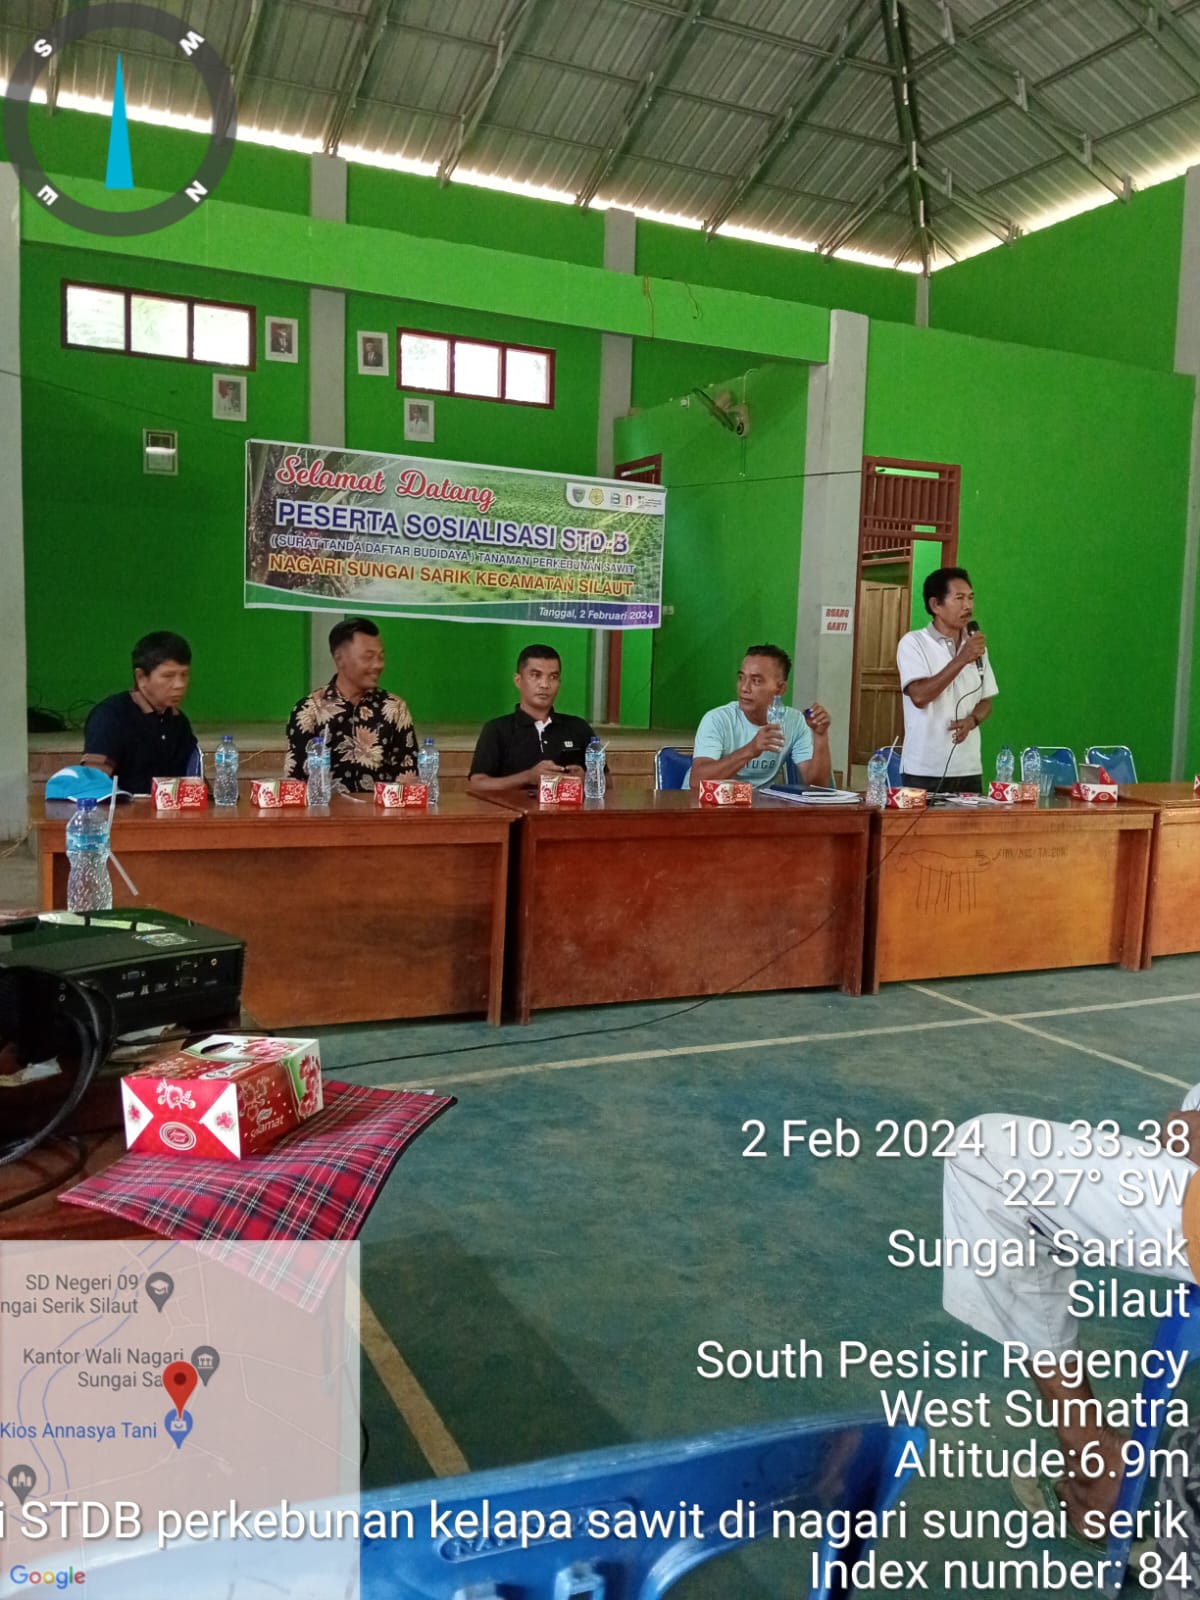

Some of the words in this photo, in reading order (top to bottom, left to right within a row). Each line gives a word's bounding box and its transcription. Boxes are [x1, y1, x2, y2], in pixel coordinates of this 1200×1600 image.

[275, 455, 385, 493] Selamat
[396, 468, 496, 514] Datang
[277, 500, 399, 535] PESERTA
[405, 512, 556, 549] SOSIALISASI
[561, 527, 629, 554] STD-B
[269, 553, 341, 575] NAGARI
[347, 561, 415, 581] SUNGAI
[420, 567, 472, 585] SARIK
[476, 571, 575, 593] KECAMATAN
[579, 580, 633, 596] SILAUT
[323, 539, 362, 552] TANDA
[365, 543, 410, 556] DAFTAR
[479, 552, 531, 566] TANAMAN
[533, 557, 601, 572] PERKEBUNAN
[602, 562, 635, 575] SAWIT
[539, 607, 577, 620] Tanggal,
[580, 609, 586, 619] 2
[588, 609, 627, 621] Februari
[629, 610, 654, 620] 2024
